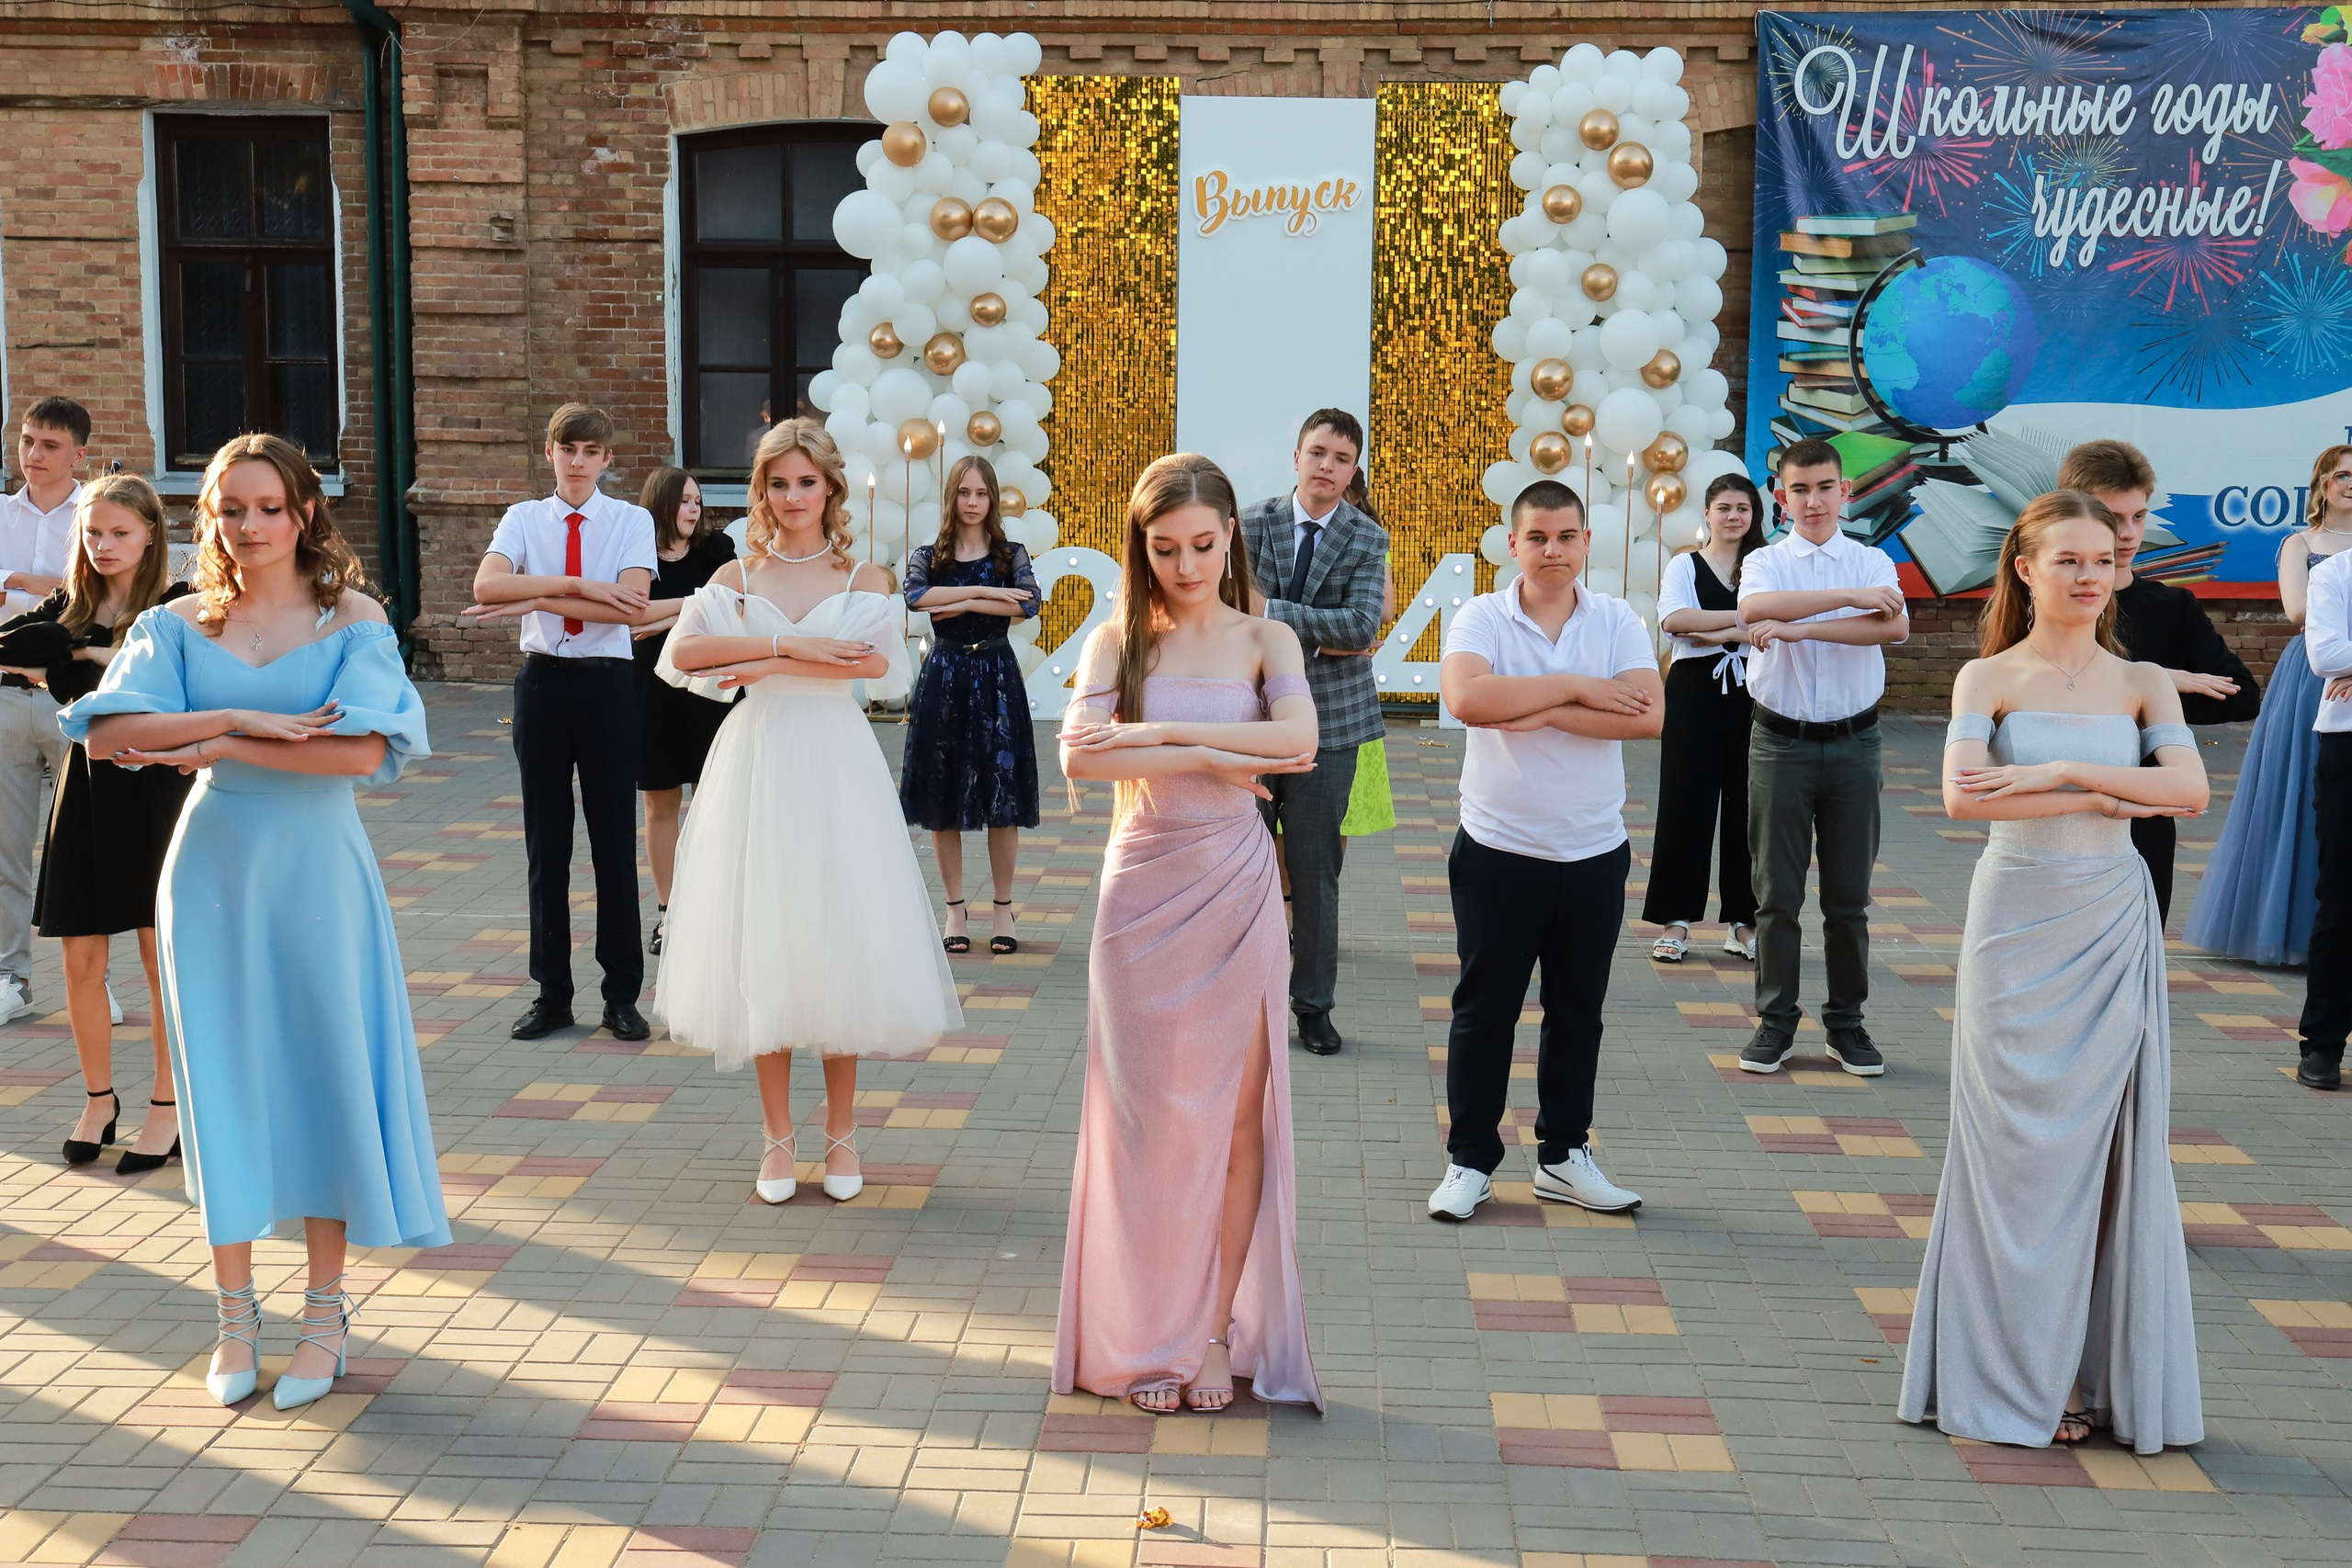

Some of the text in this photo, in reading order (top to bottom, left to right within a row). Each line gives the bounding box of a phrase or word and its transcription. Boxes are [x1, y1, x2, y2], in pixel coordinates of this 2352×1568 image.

[1794, 44, 2278, 164] Школьные годы
[1194, 169, 1363, 236] Выпуск
[2030, 159, 2283, 267] чудесные!
